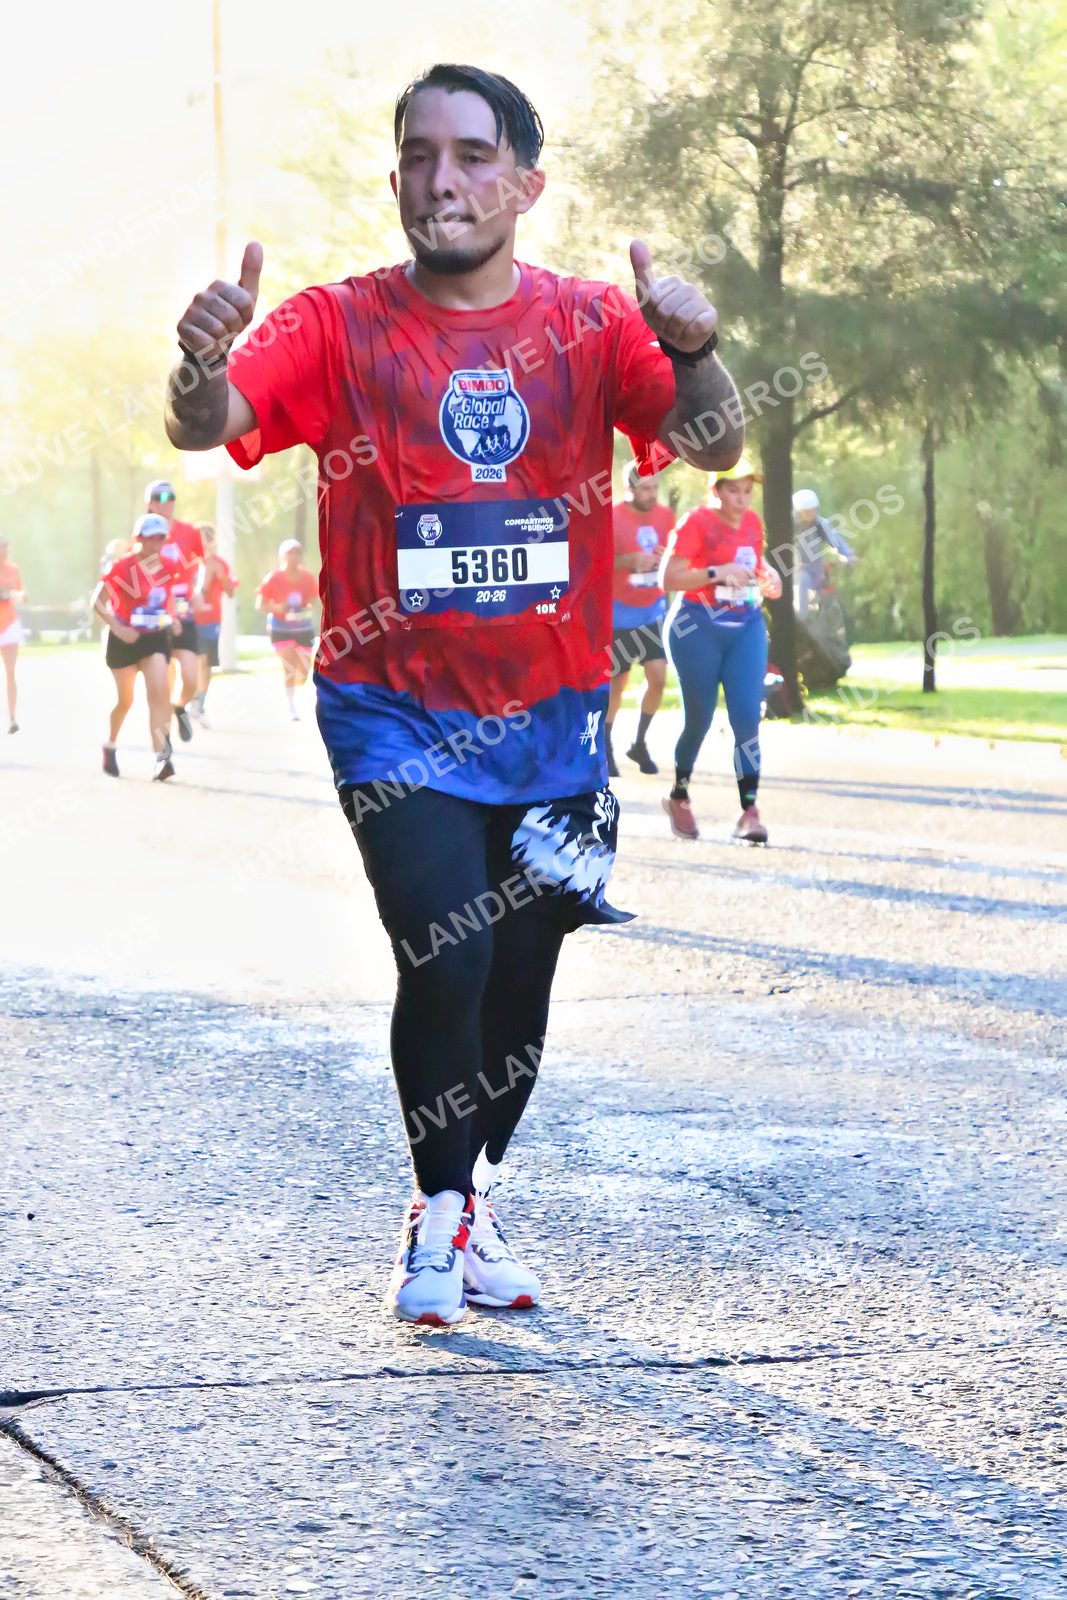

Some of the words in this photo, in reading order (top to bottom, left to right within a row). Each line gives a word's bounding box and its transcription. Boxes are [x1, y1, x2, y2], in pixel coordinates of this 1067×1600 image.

[459, 379, 505, 391] BIMBO
[462, 397, 505, 414] Global
[453, 413, 489, 429] Race
[475, 469, 502, 479] 2026
[451, 547, 528, 584] 5360
[535, 602, 556, 614] 10K
